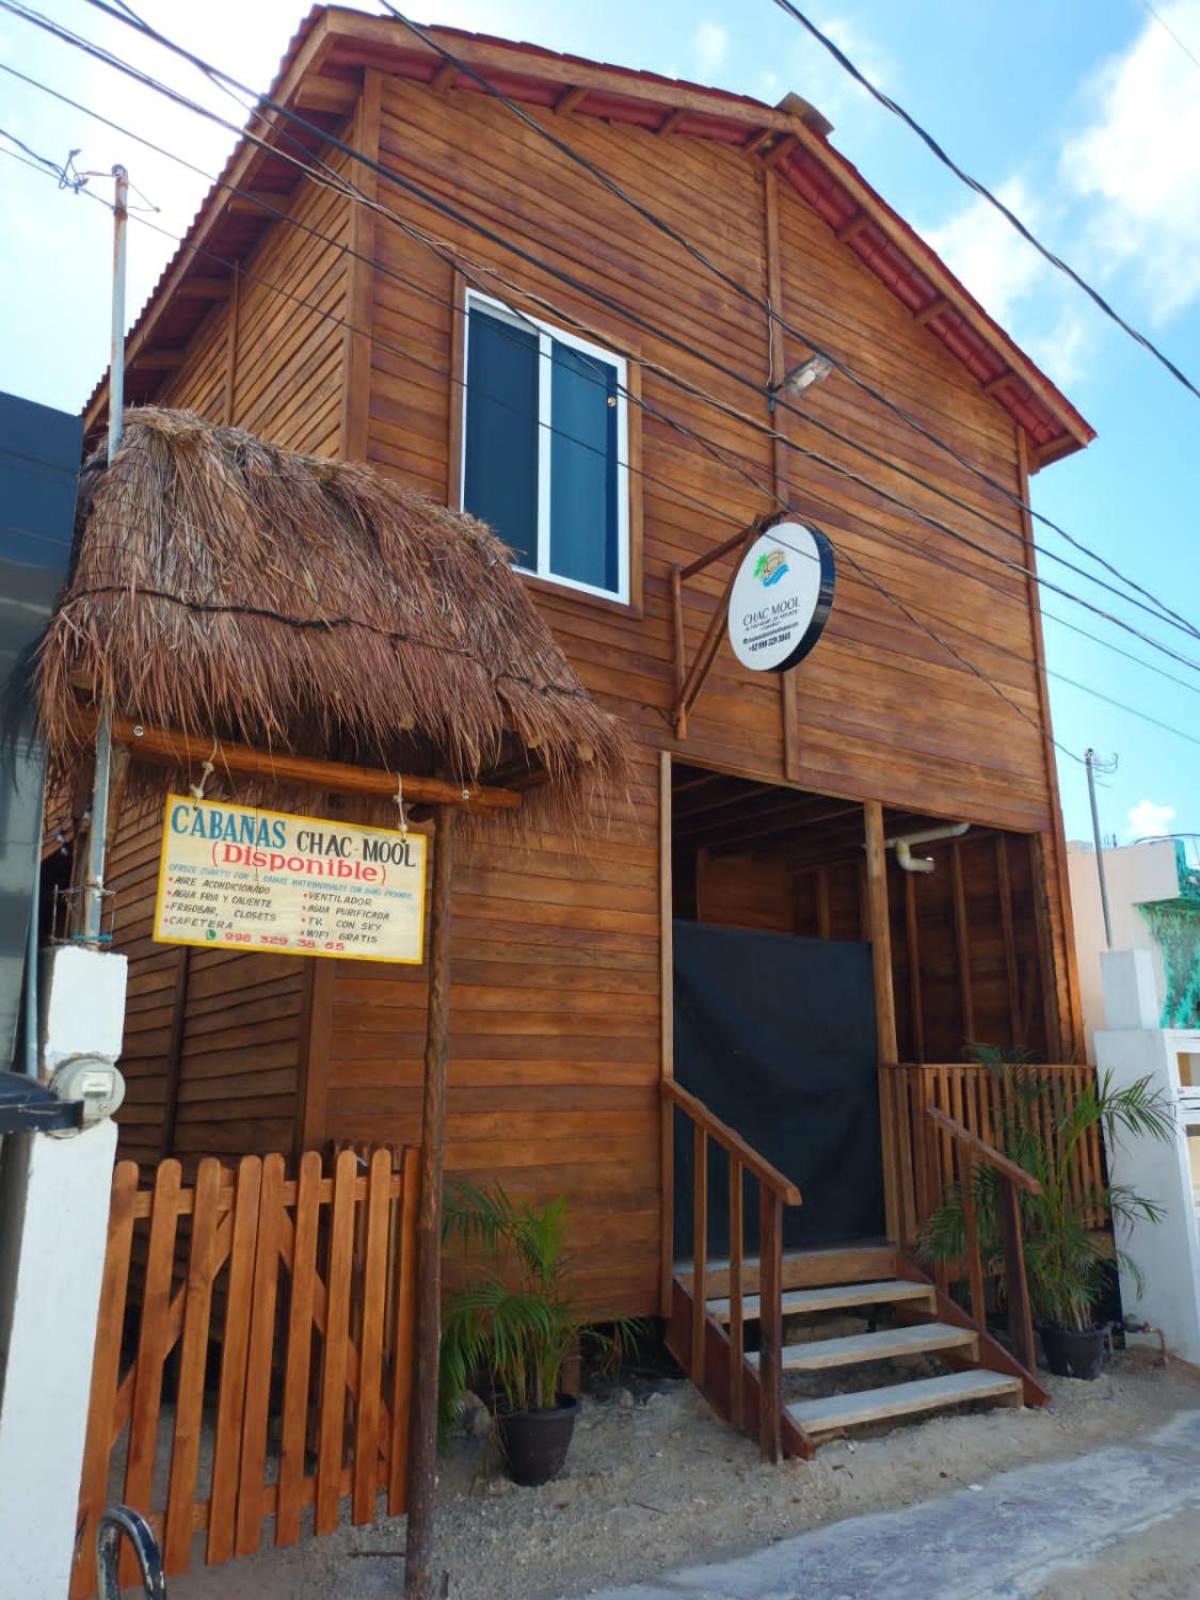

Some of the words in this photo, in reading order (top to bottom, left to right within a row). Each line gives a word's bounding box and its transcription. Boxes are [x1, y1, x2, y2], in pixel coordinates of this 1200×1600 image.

[743, 608, 769, 626] CHAC
[771, 596, 800, 614] MOOL
[171, 805, 286, 849] CABAÑAS
[296, 830, 352, 858] CHAC
[362, 838, 416, 867] MOOL
[174, 876, 197, 886] AIRE
[202, 880, 271, 894] ACONDICIONADO
[172, 889, 196, 900] AGUA
[200, 892, 219, 902] FRIA
[231, 896, 272, 908] CALIENTE
[308, 891, 373, 906] VENTILADOR
[233, 909, 277, 921] CLOSETS
[307, 905, 330, 913] AGUA
[335, 907, 390, 920] PURIFICADA
[169, 917, 233, 929] CAFETERA
[335, 920, 355, 929] CON
[361, 922, 382, 931] SKY
[306, 930, 329, 939] WIFI
[338, 933, 378, 943] GRATIS
